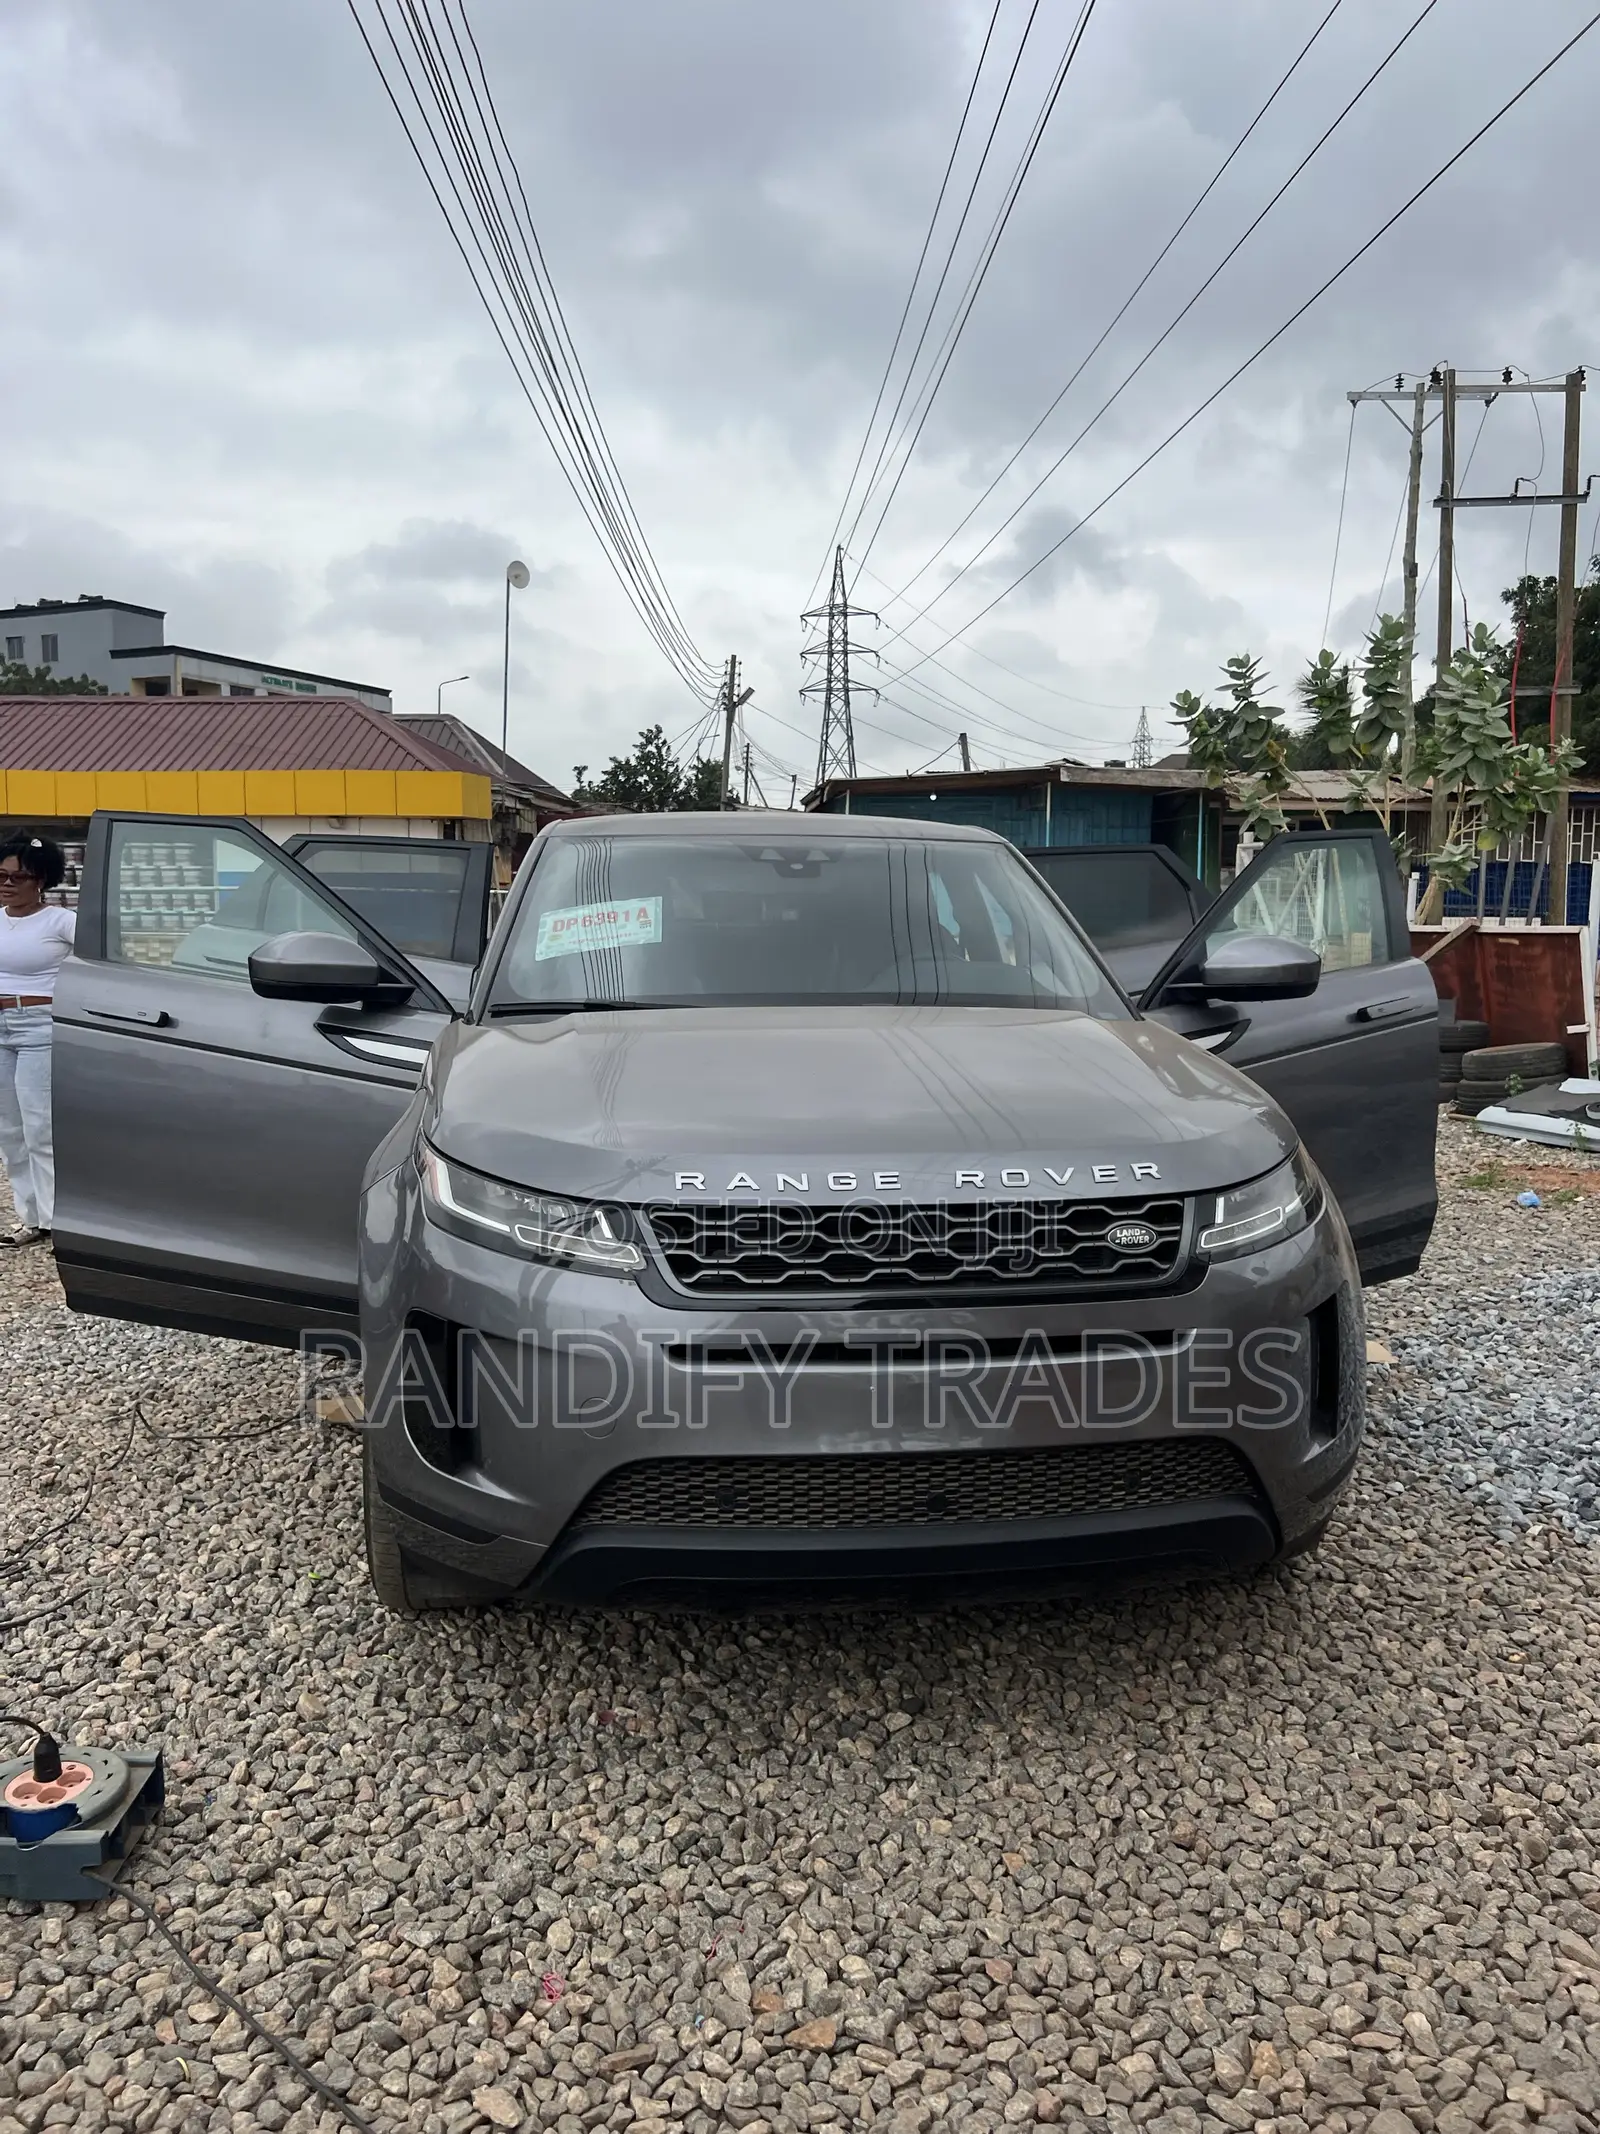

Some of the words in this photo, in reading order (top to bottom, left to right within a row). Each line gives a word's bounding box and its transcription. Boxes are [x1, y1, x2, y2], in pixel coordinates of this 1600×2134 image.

[552, 917, 578, 933] DP
[636, 906, 650, 921] A
[674, 1171, 902, 1192] RANGE
[955, 1162, 1162, 1188] ROVER
